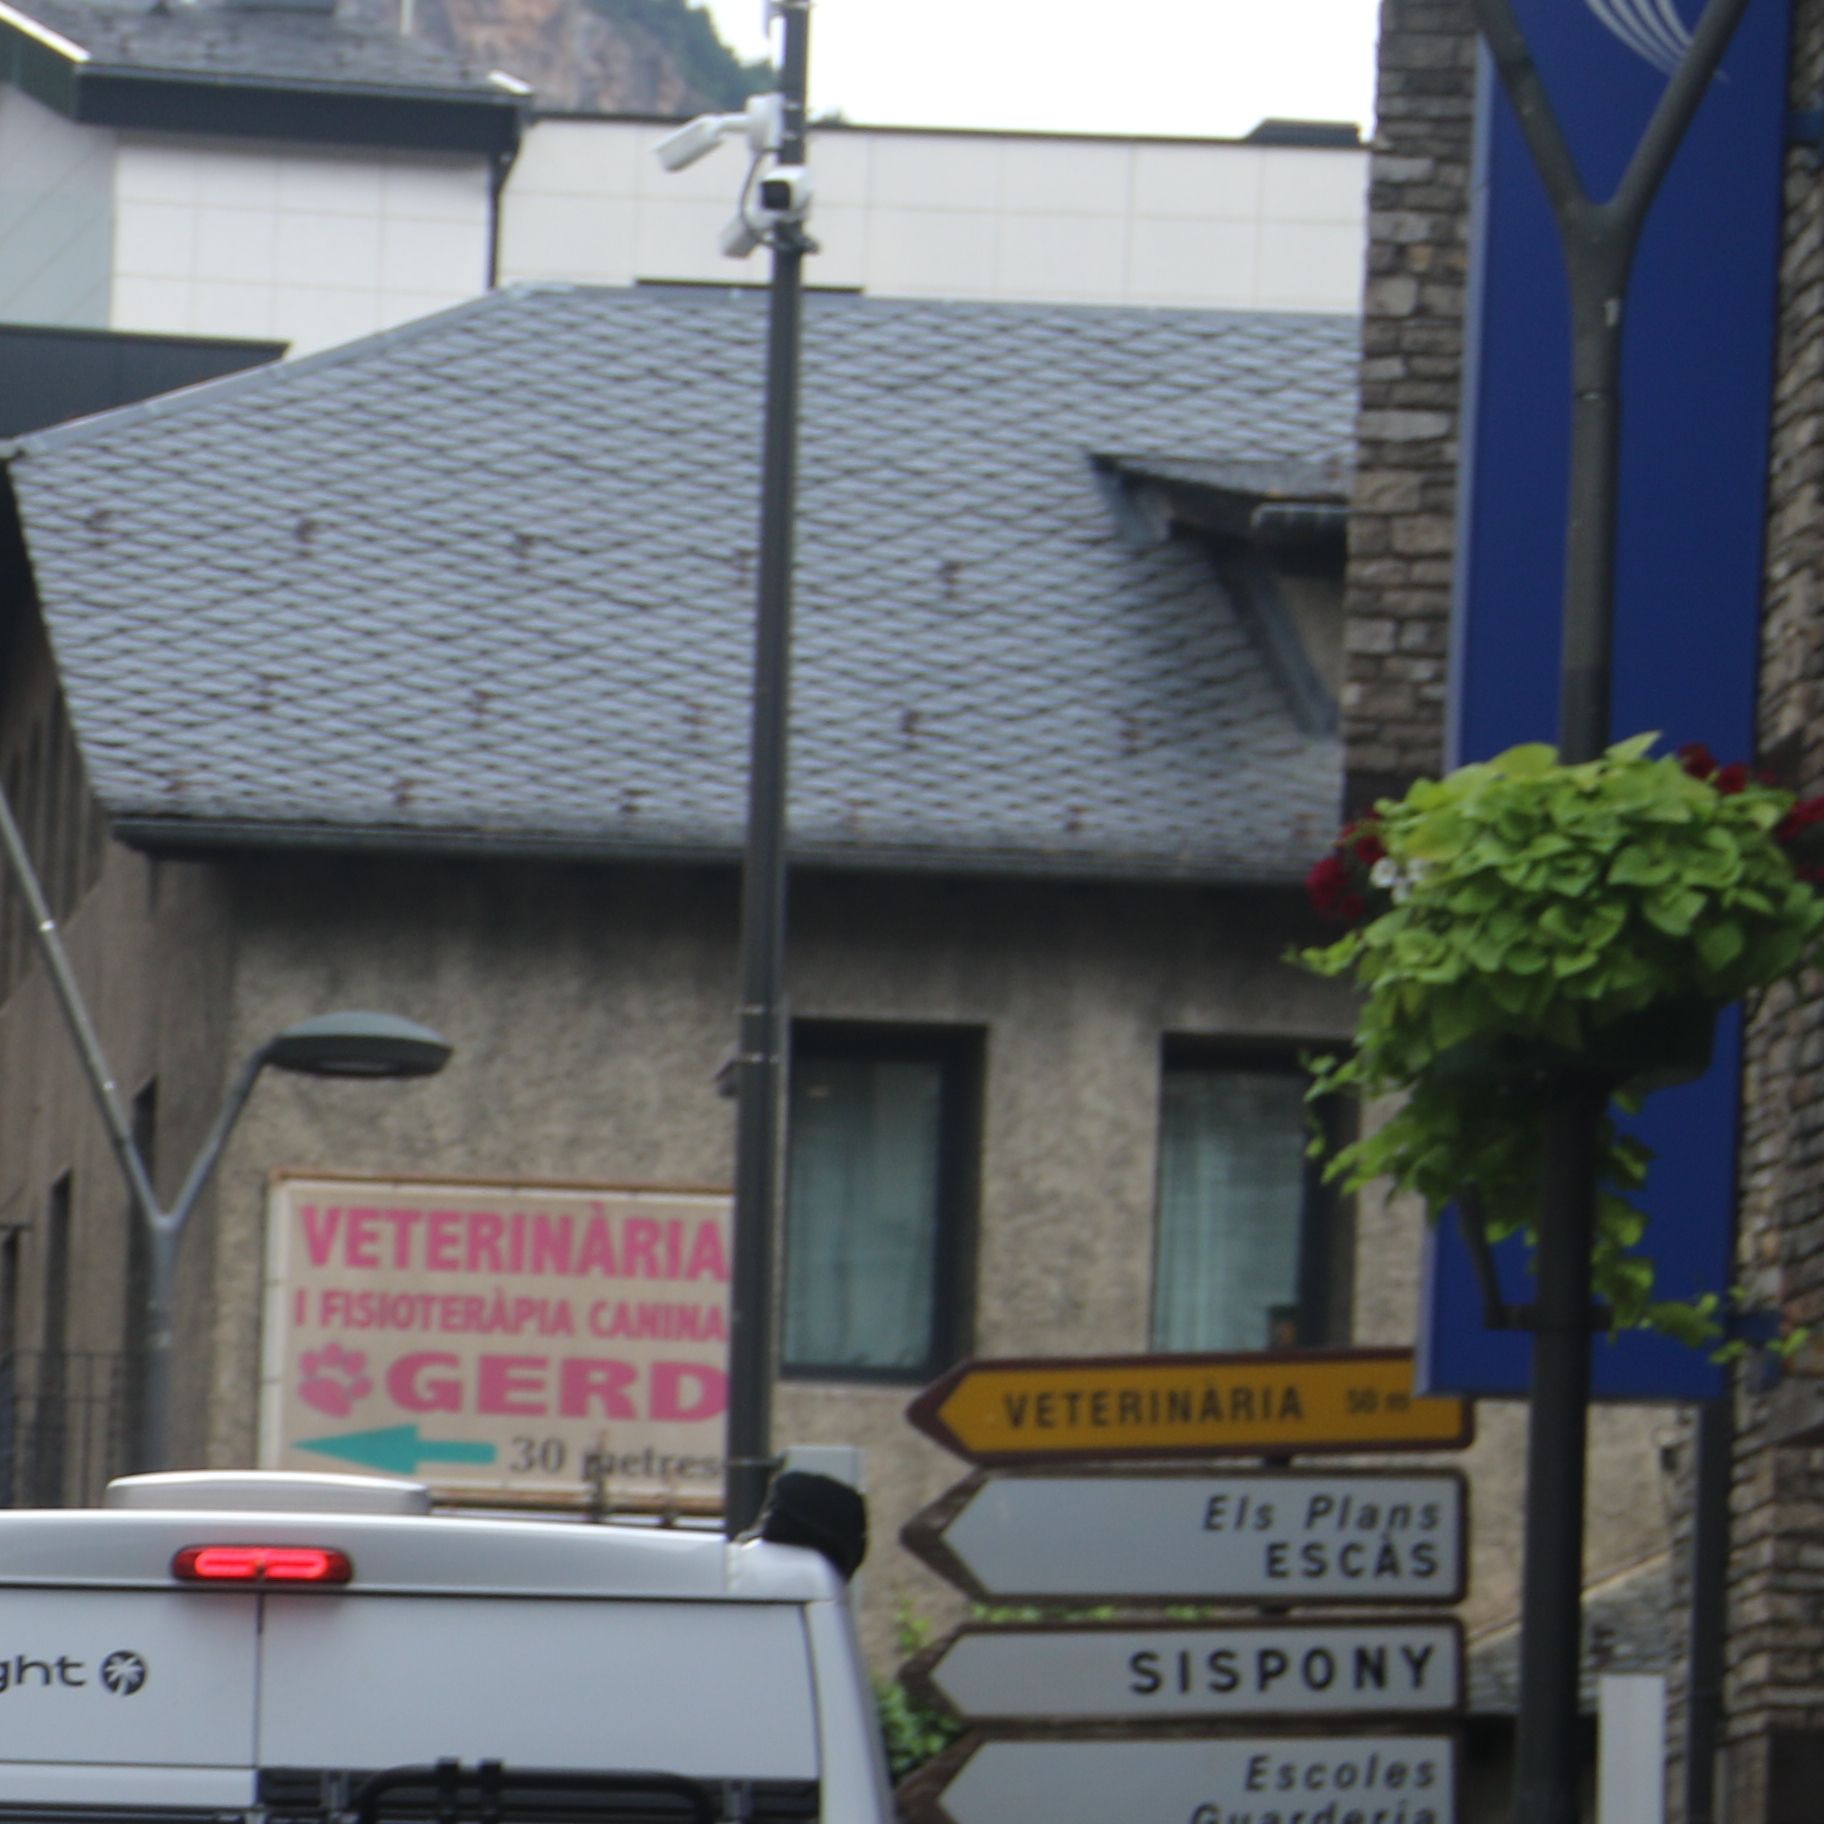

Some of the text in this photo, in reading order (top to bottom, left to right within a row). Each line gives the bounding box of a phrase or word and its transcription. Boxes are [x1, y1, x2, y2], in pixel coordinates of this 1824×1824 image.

[300, 1201, 730, 1282] VETERINÀRIA
[294, 1287, 728, 1343] I FISIOTERÀPIA CANINA
[384, 1351, 729, 1423] GERD
[1004, 1378, 1305, 1430] VETERINÀRIA
[510, 1435, 565, 1474] 30
[1203, 1494, 1440, 1532] Els Plans
[1265, 1533, 1439, 1579] ESCÀS
[1129, 1643, 1436, 1695] SISPONY
[1245, 1753, 1436, 1792] Escoles
